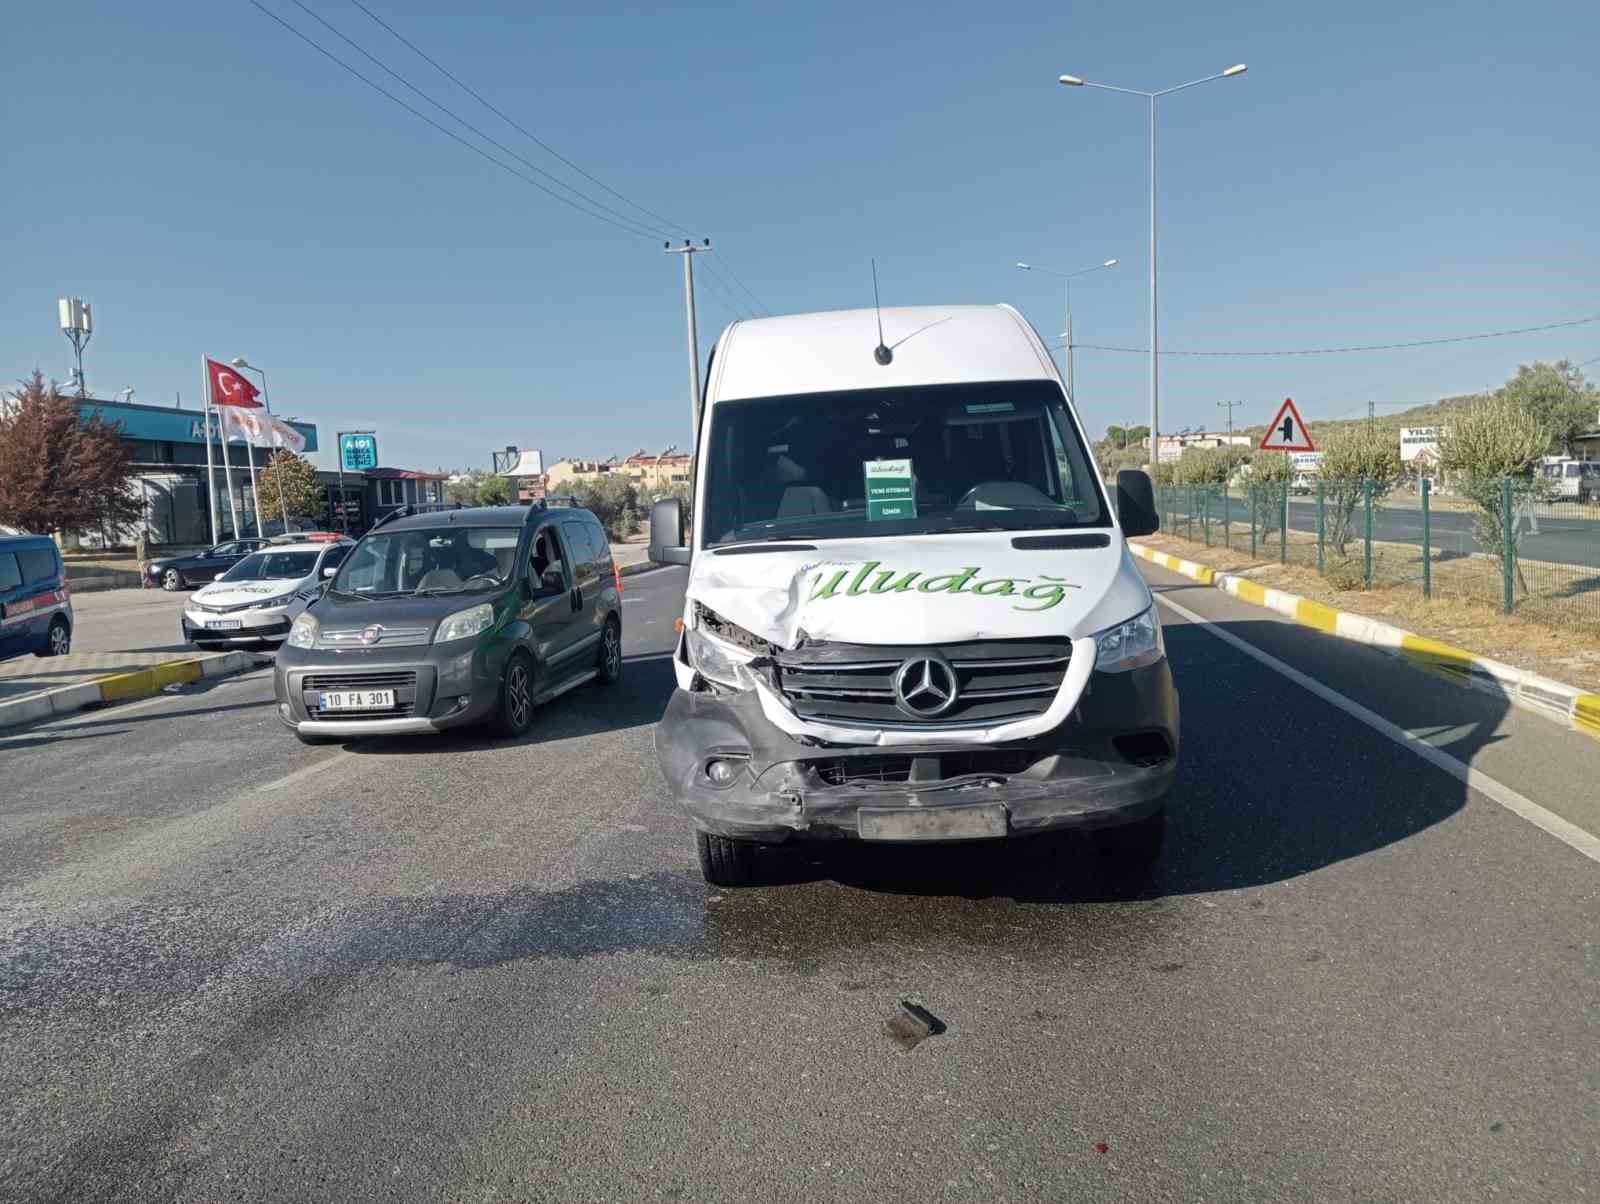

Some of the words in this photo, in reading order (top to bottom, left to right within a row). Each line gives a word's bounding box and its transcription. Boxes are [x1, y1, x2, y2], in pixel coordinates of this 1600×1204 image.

[329, 694, 341, 706] 10
[349, 693, 362, 705] FA
[369, 692, 389, 705] 301
